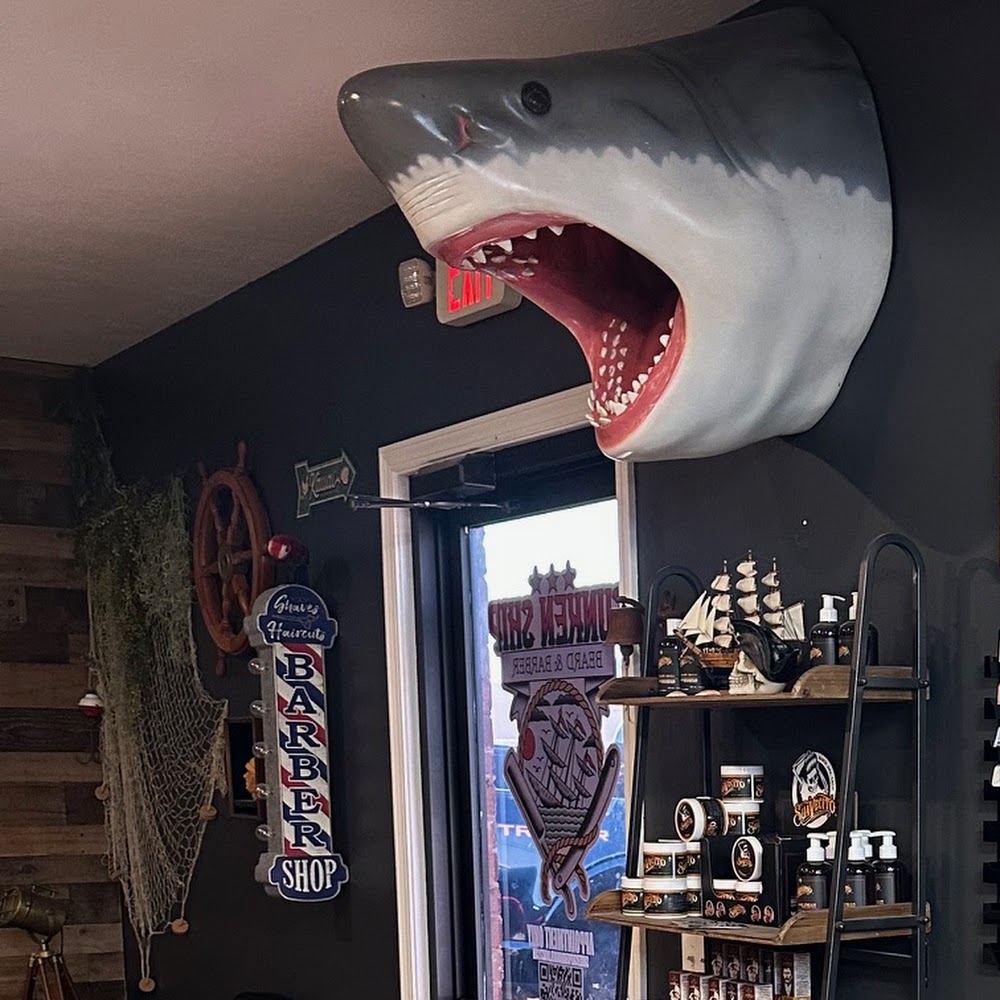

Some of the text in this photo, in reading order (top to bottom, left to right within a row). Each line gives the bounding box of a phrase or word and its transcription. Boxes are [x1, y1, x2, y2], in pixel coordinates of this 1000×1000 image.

[273, 594, 320, 615] Shaves
[266, 620, 326, 641] Haircuts
[282, 653, 325, 848] BARBER
[281, 858, 337, 893] SHOP
